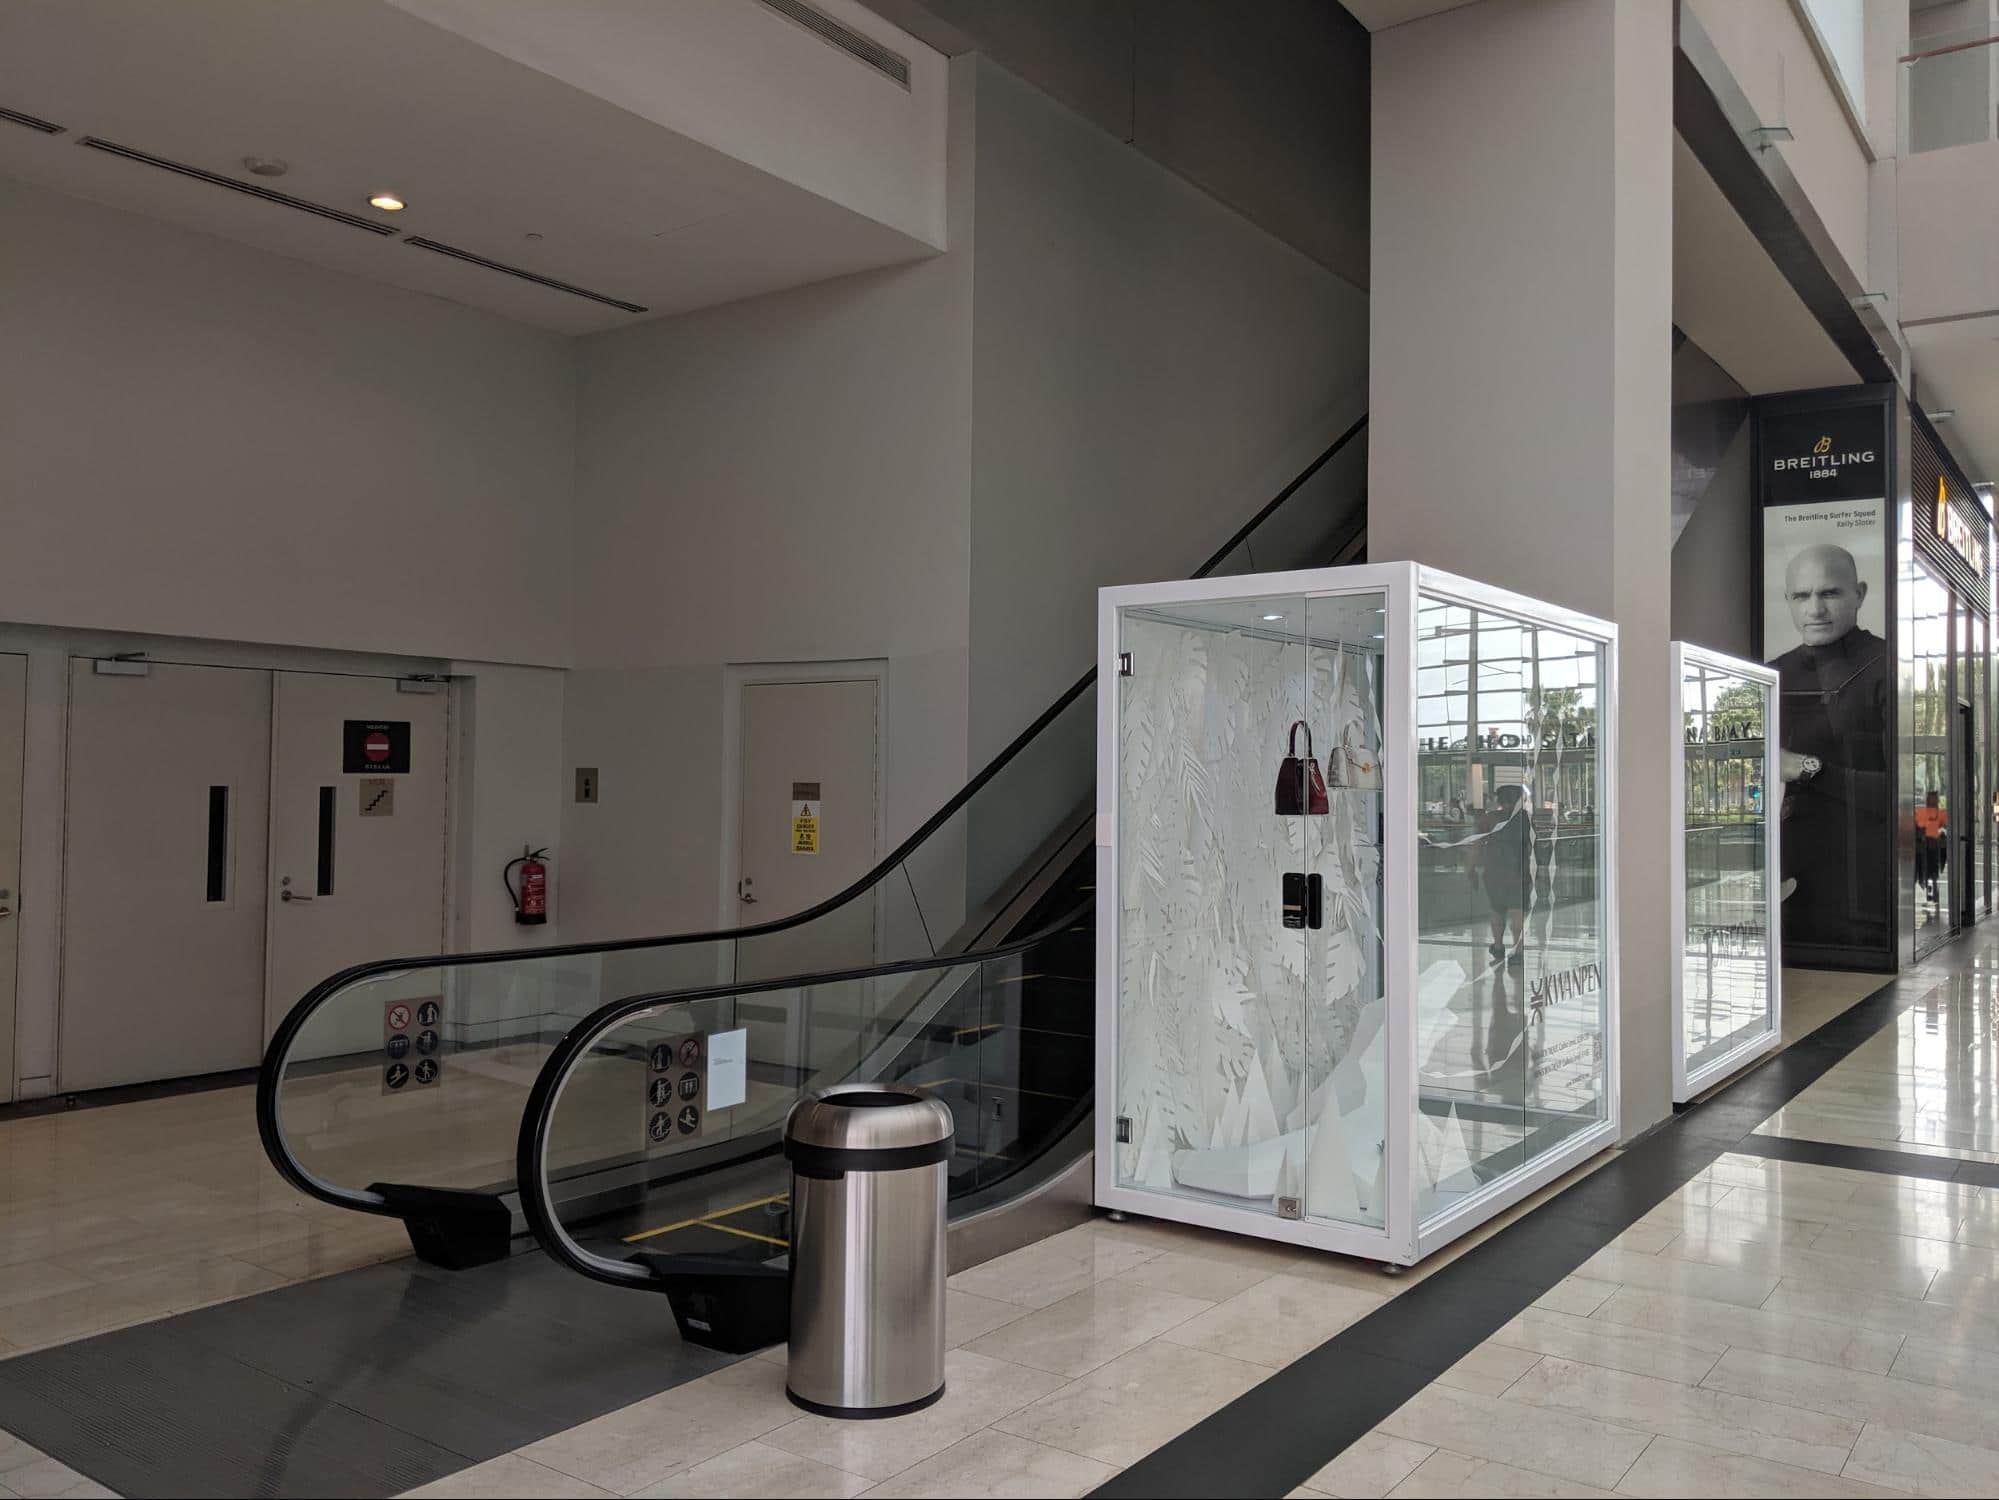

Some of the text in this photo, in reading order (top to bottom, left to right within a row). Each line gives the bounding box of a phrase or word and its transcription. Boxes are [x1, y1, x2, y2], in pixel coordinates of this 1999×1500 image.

[1774, 451, 1875, 471] BREITLING
[1809, 469, 1837, 479] 1884
[1798, 512, 1828, 522] Breitling
[1829, 511, 1851, 520] Surfer
[1853, 509, 1876, 519] Squad
[1544, 960, 1602, 1008] KWANPEN
